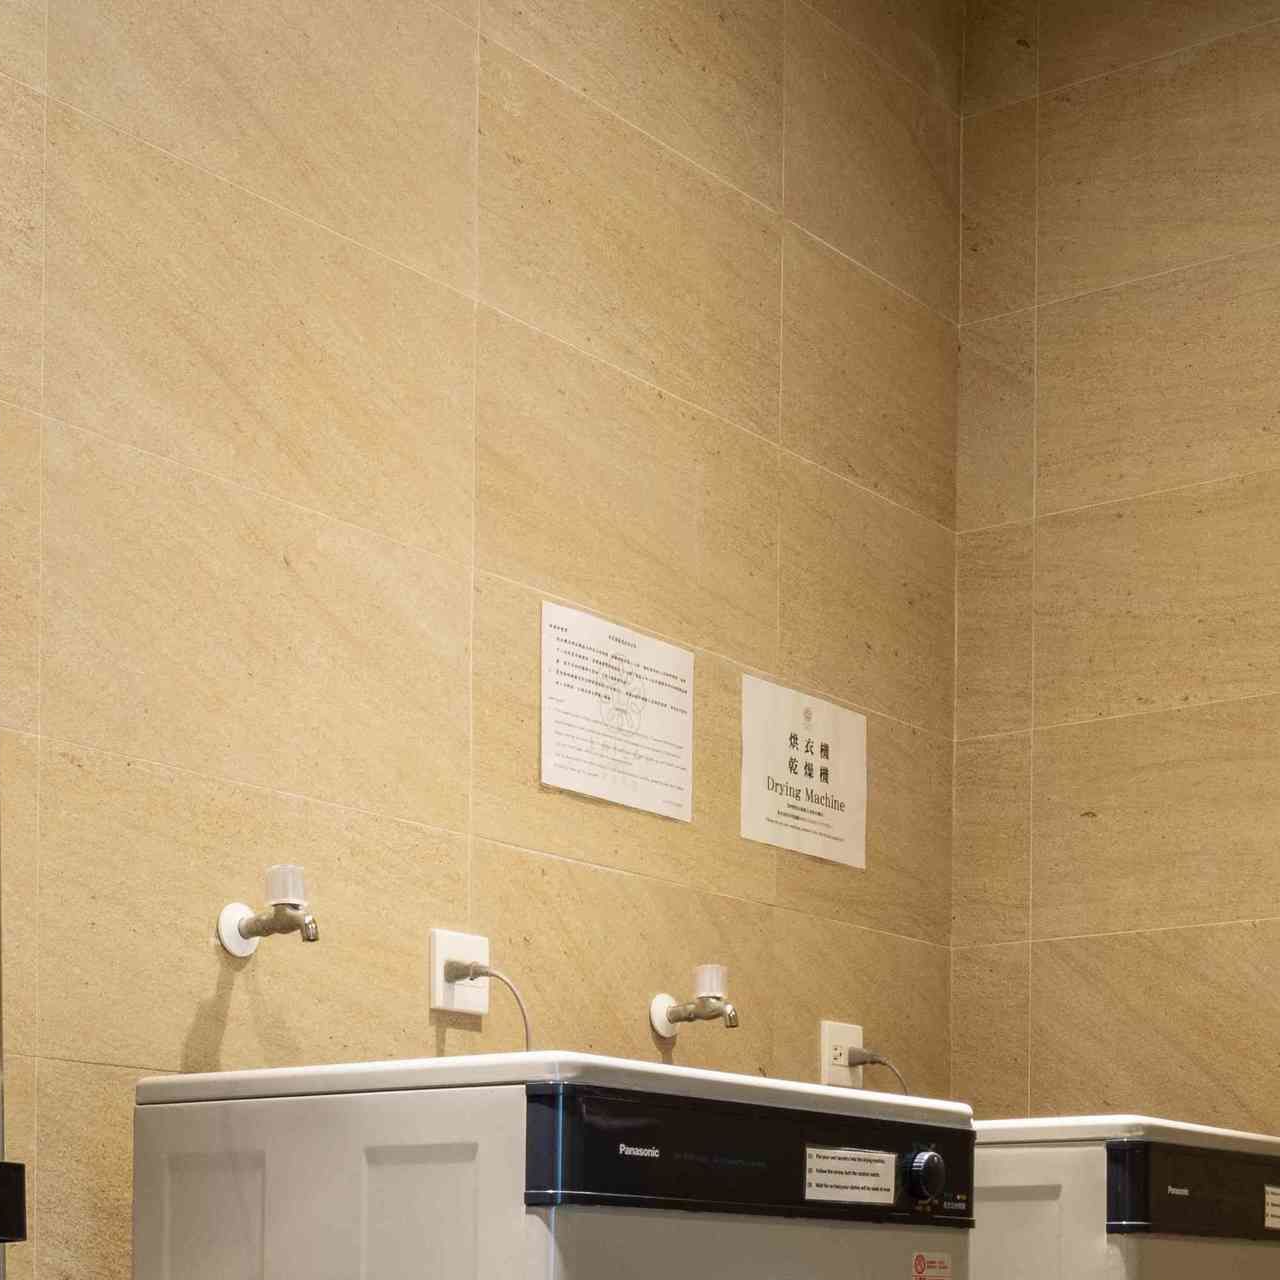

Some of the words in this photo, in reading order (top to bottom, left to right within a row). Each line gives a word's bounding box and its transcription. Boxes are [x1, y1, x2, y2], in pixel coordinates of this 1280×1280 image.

[767, 776, 801, 800] Drying
[805, 787, 845, 813] Machine
[619, 1143, 660, 1158] Panasonic
